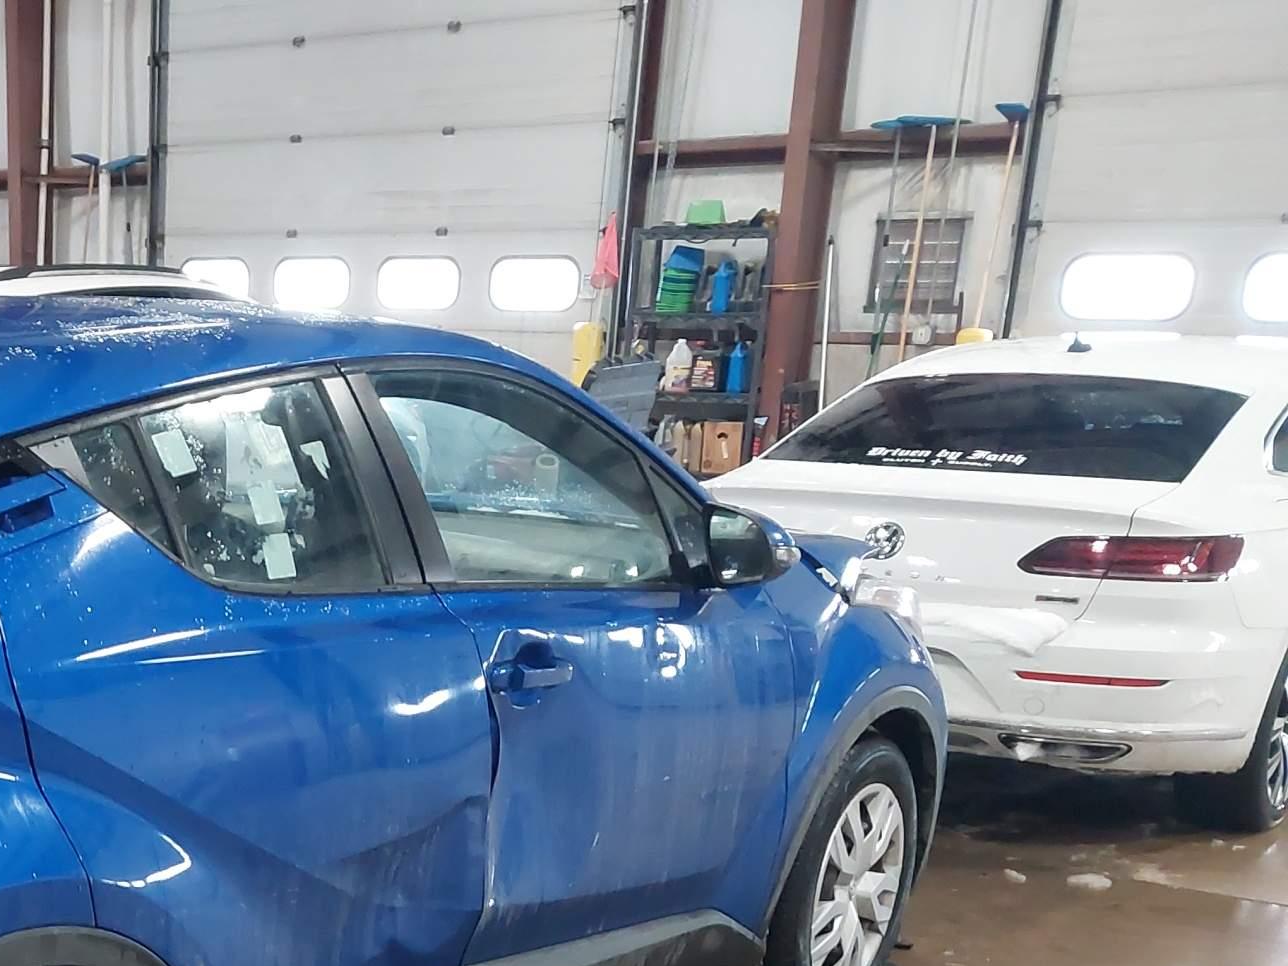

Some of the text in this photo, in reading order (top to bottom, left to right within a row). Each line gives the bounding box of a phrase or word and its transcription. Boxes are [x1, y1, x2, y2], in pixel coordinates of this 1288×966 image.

[866, 446, 932, 457] Driven
[936, 448, 964, 461] by
[966, 449, 1028, 466] Faith
